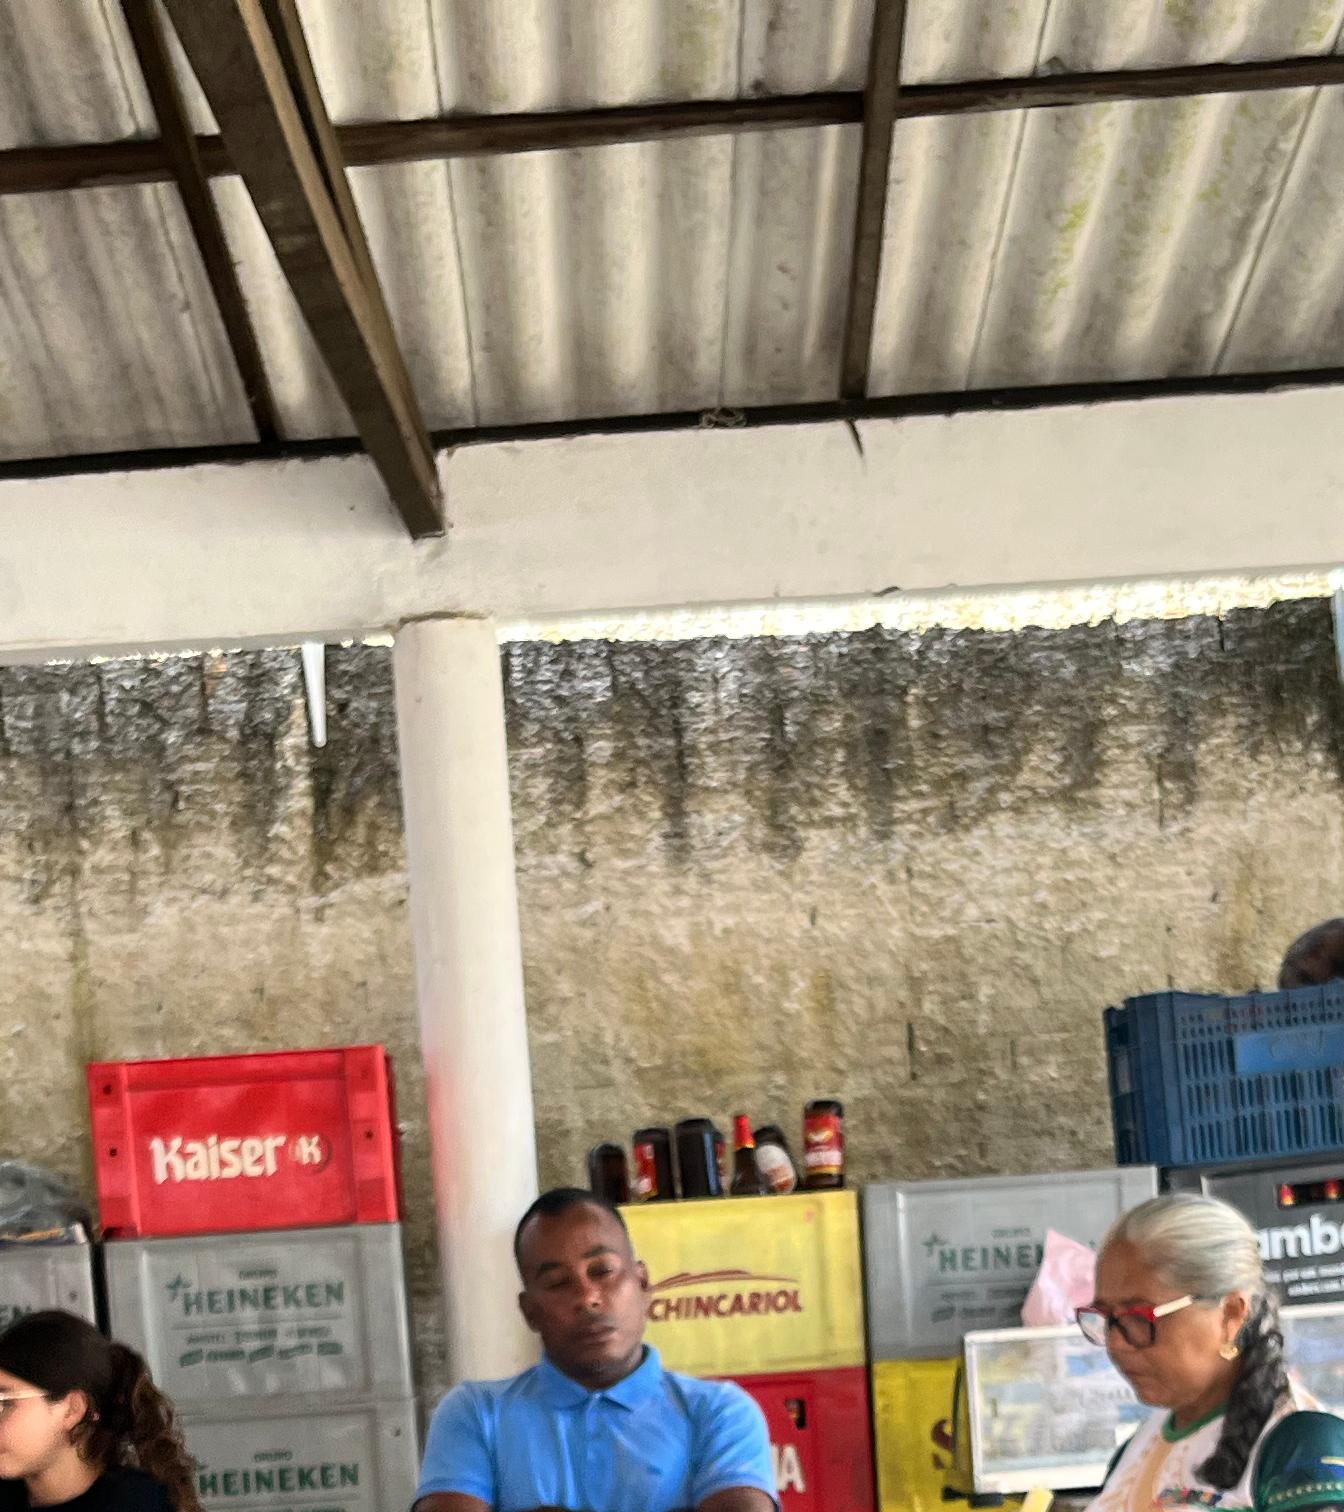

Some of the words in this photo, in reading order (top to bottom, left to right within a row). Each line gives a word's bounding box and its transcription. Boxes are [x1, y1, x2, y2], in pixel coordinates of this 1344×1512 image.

[149, 1135, 288, 1185] Kaiser
[939, 1243, 1045, 1274] HEINE
[183, 1281, 344, 1317] HEINEKEN
[647, 1289, 803, 1322] CHINCARIOL
[199, 1462, 360, 1497] HEINEKEN
